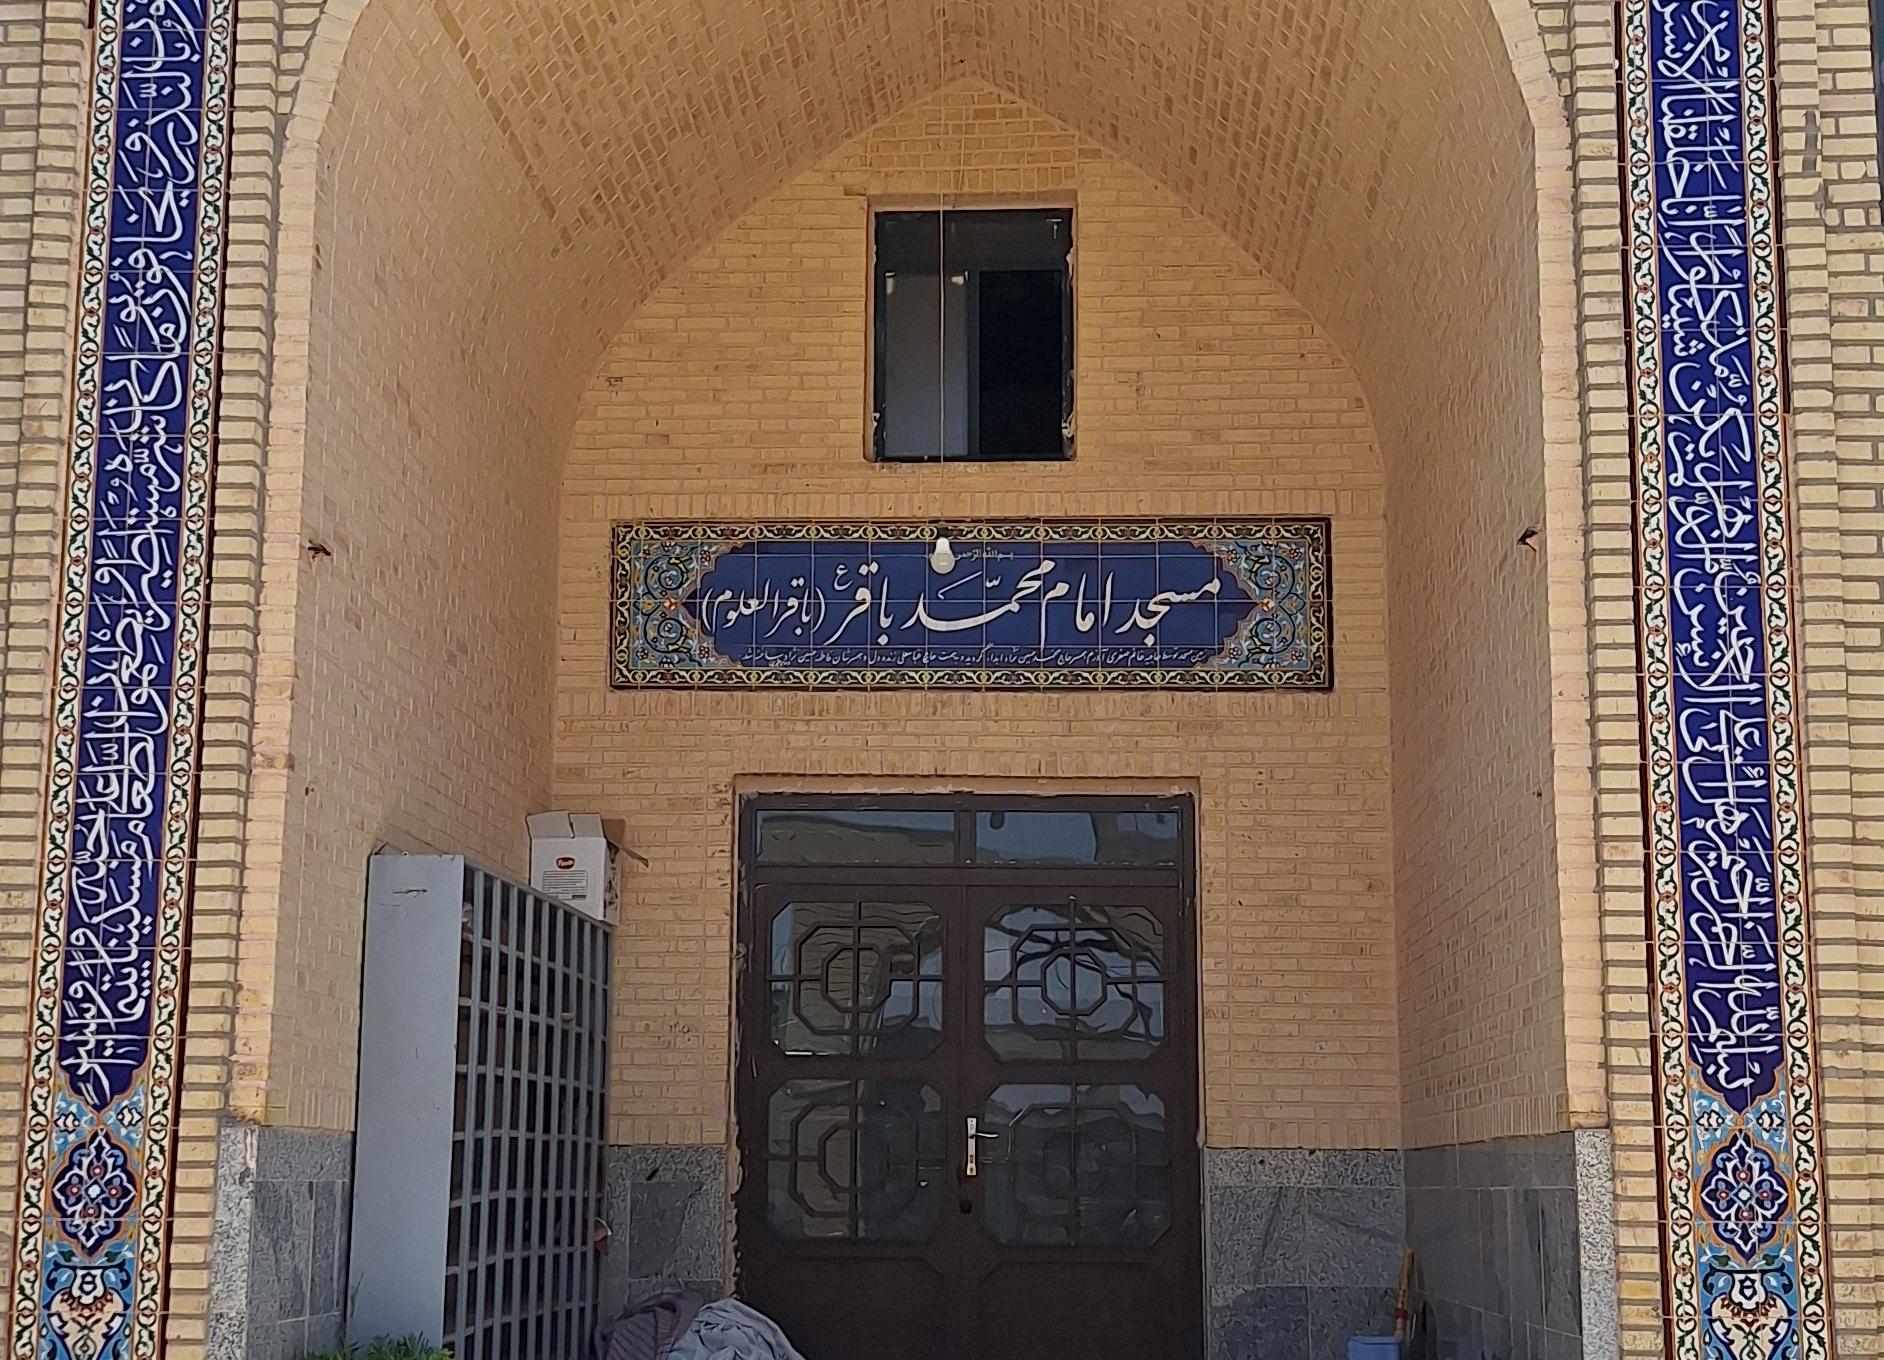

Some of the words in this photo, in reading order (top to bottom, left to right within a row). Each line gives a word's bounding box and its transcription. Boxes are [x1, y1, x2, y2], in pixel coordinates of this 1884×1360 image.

[823, 560, 895, 646] باقر
[1041, 571, 1114, 650] امام
[1114, 577, 1221, 647] مسجد
